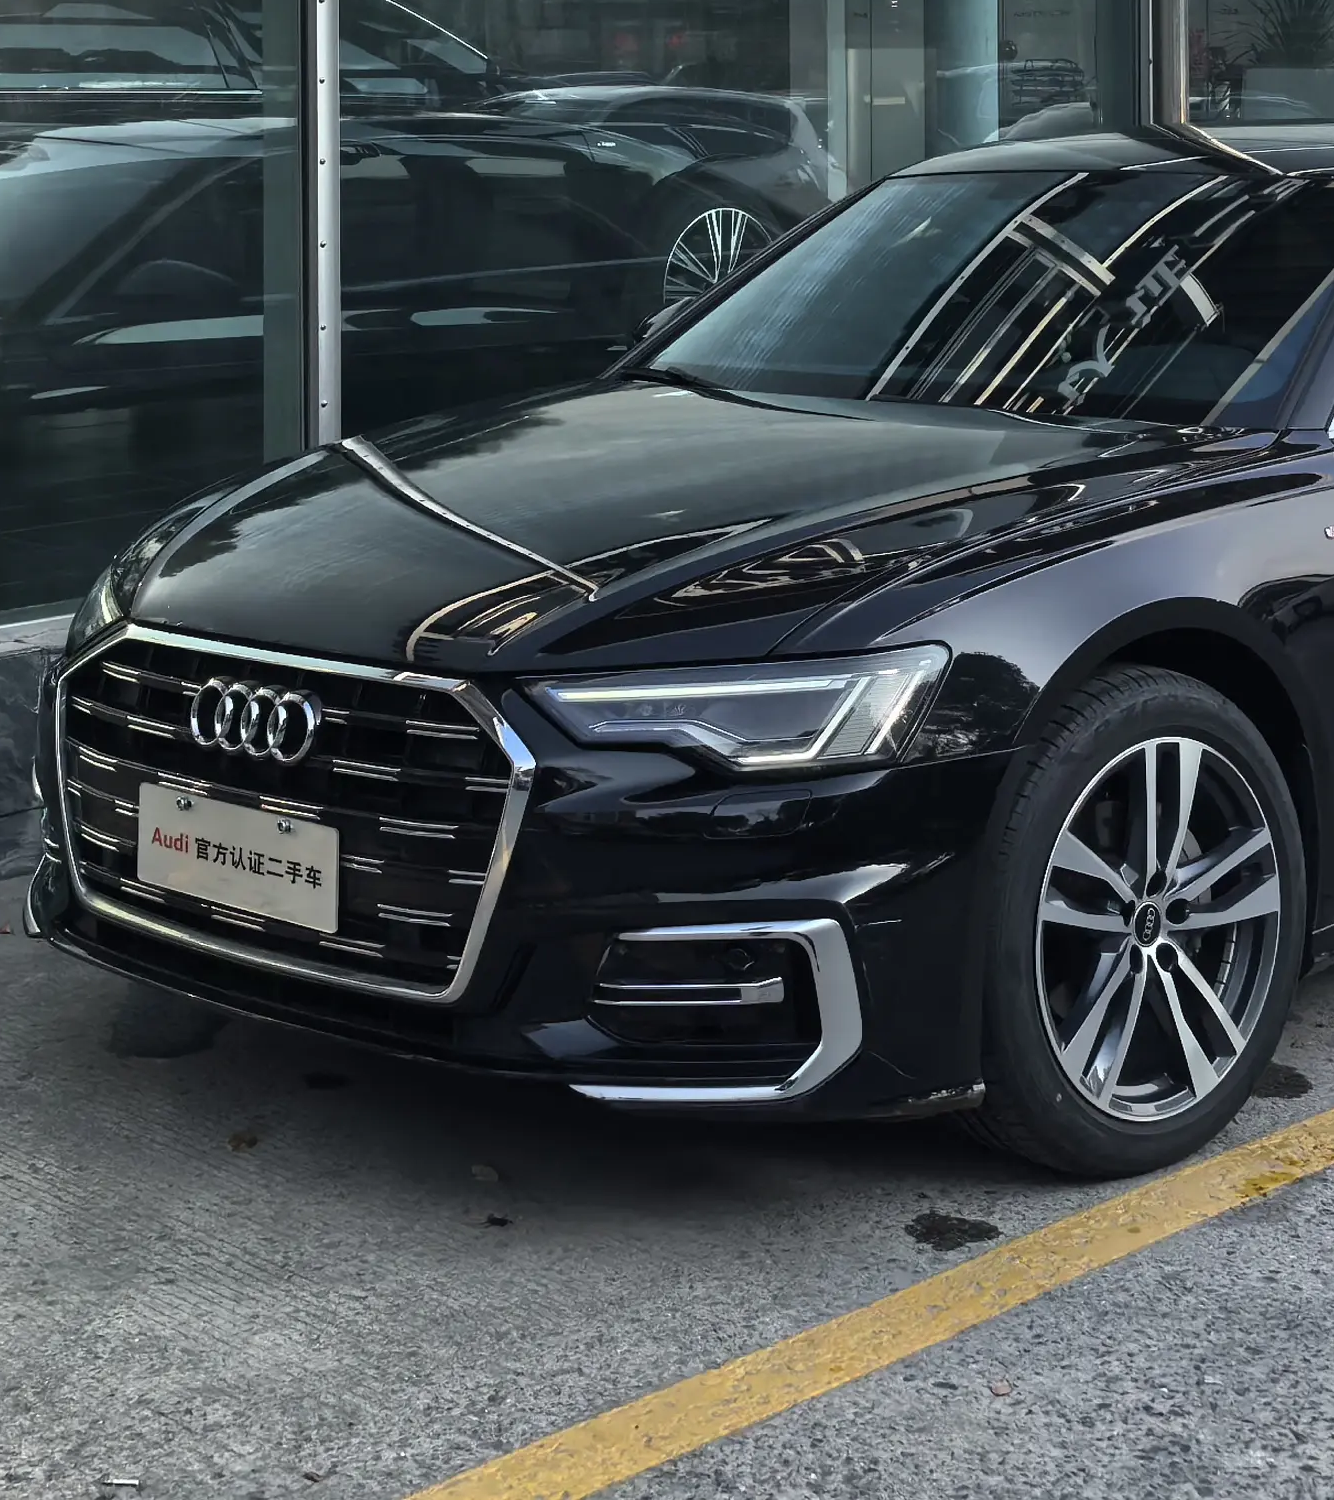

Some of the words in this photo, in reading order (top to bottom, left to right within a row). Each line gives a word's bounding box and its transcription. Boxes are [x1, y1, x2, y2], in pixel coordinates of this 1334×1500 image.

[151, 826, 190, 855] Audi
[195, 836, 323, 890] 官方认证二手车
